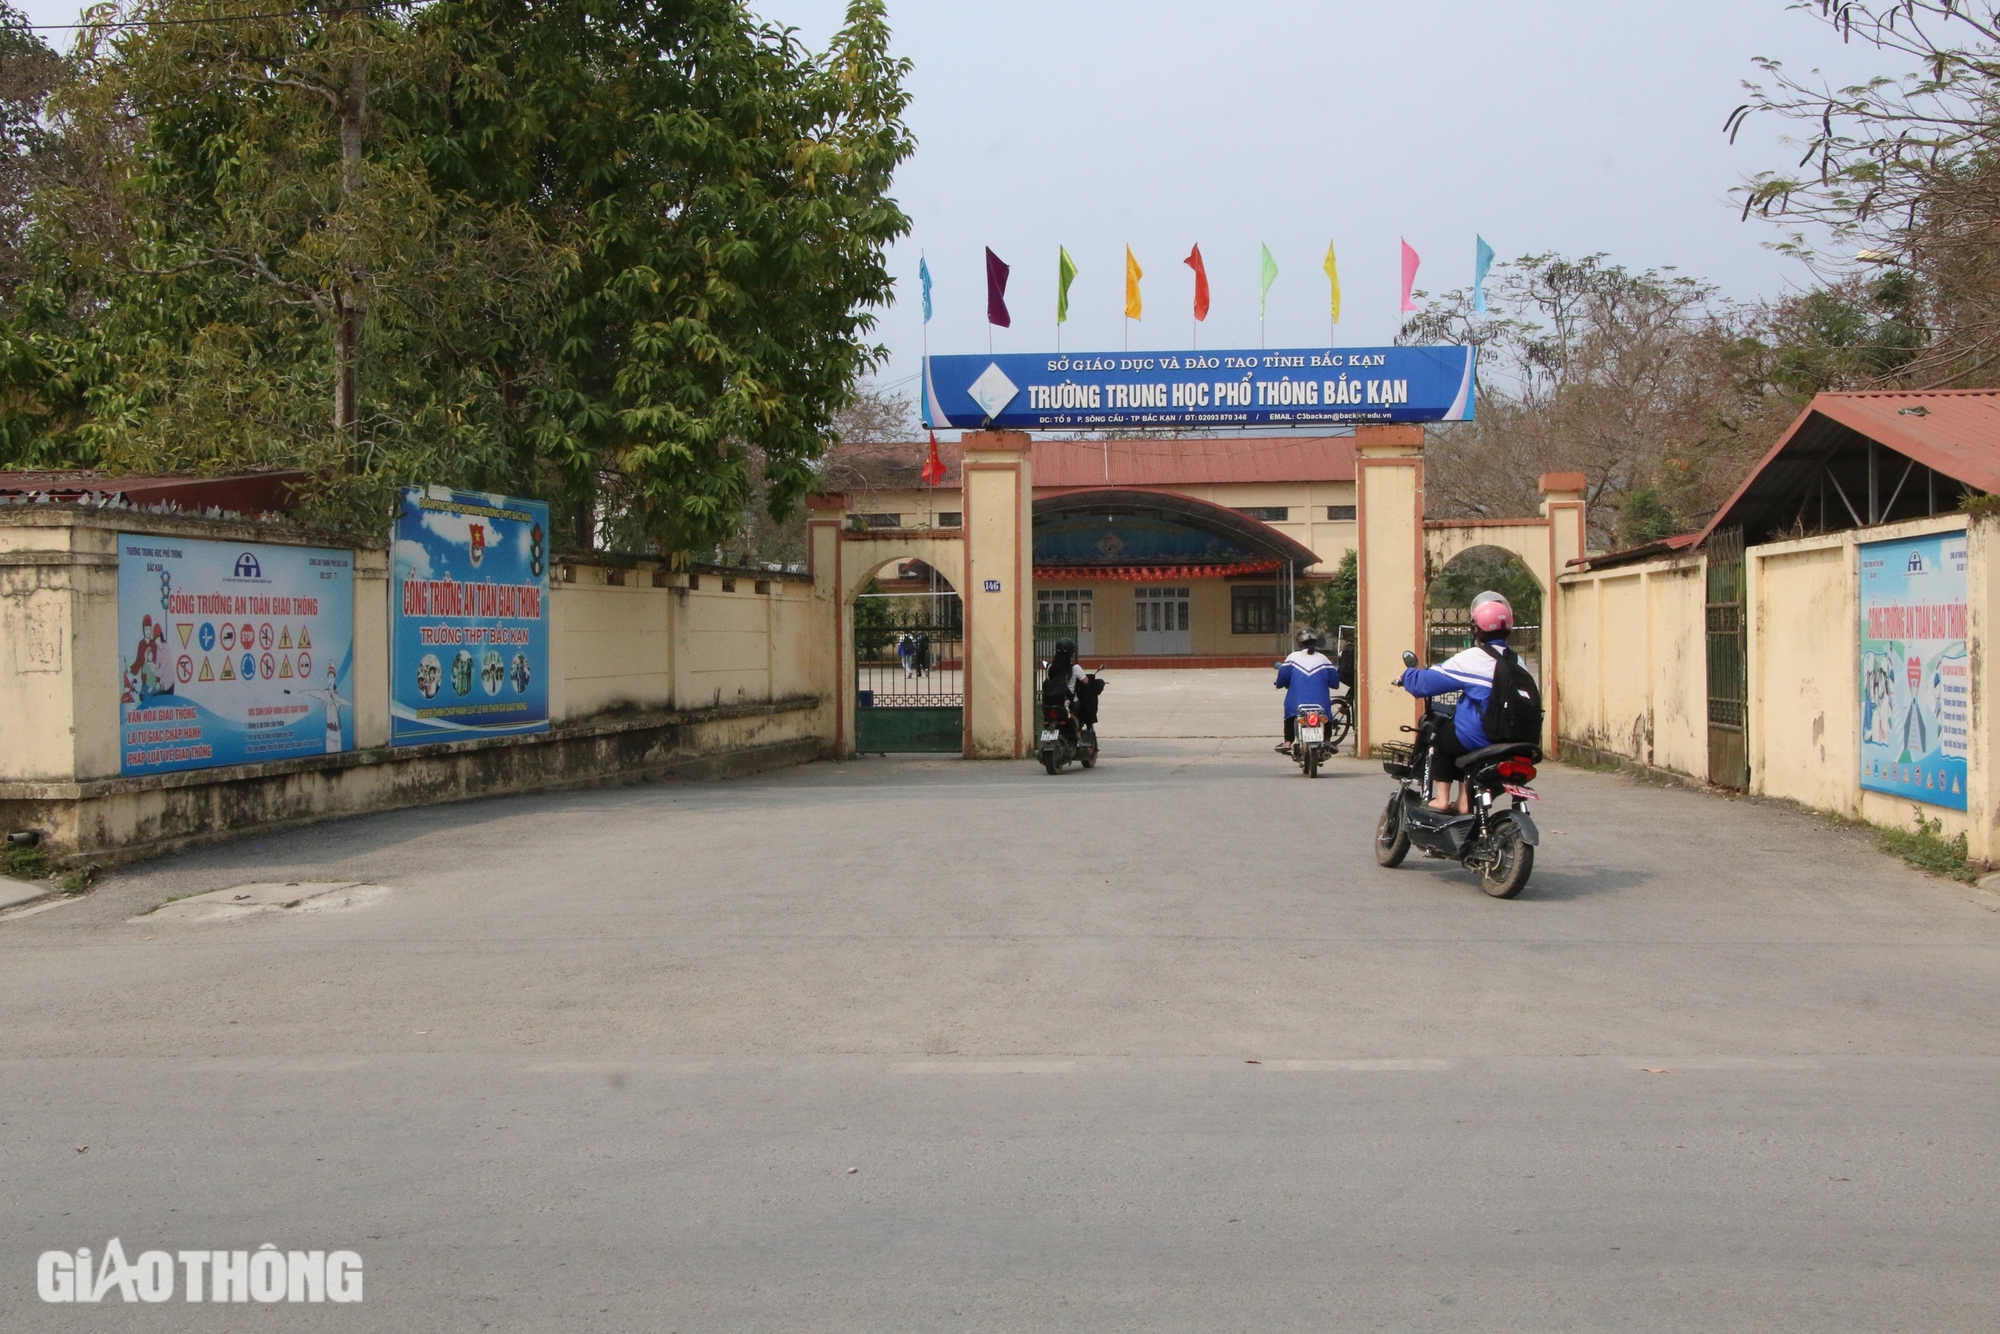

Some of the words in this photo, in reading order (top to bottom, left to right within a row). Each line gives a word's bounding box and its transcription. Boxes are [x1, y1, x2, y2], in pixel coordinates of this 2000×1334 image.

[1047, 355, 1069, 371] SỞ
[1073, 357, 1116, 371] GIÁO
[1120, 358, 1154, 373] DỤC
[1159, 356, 1181, 370] VÀ
[1185, 355, 1220, 369] ĐÀO
[1263, 352, 1305, 368] TỈNH
[1310, 351, 1343, 367] BẮC
[1348, 354, 1386, 369] KẠN
[1028, 379, 1100, 409] TRƯỜNG
[1105, 383, 1167, 408] TRUNG
[1172, 382, 1209, 411] HỌC
[1214, 371, 1253, 406] PHỔ
[1256, 376, 1318, 406] THÔNG
[1323, 372, 1362, 405] BẮC
[1367, 380, 1408, 408] KẠN
[1054, 413, 1065, 423] TỔ
[1085, 414, 1106, 423] SÔNG
[1142, 412, 1158, 422] BẮC
[1160, 414, 1176, 423] KẠN
[403, 565, 428, 617] CỔNG
[429, 571, 462, 617] TRƯỜNG
[463, 582, 475, 617] AN
[476, 576, 497, 618] TOÀN
[498, 584, 516, 618] GIAO
[517, 579, 541, 619] THÔNG
[985, 581, 999, 591] 146
[169, 587, 195, 614] CỔNG
[197, 591, 232, 615] TRƯỜNG
[235, 596, 247, 615] AN
[249, 593, 271, 616] TOÀN
[273, 597, 291, 616] GIAO
[293, 594, 318, 616] THÔNG
[1906, 605, 1914, 639] AN
[1915, 596, 1931, 639] TOÀN
[1932, 604, 1946, 639] GIAO
[1947, 595, 1968, 639] THÔNG
[421, 622, 462, 645] TRƯỜNG
[464, 627, 488, 645] THPT
[489, 621, 509, 645] BẮC
[510, 627, 529, 649] KẠN
[158, 708, 173, 722] GIAO
[175, 704, 197, 720] THÔNG
[174, 747, 190, 762] GIAO
[191, 743, 212, 759] THÔNG
